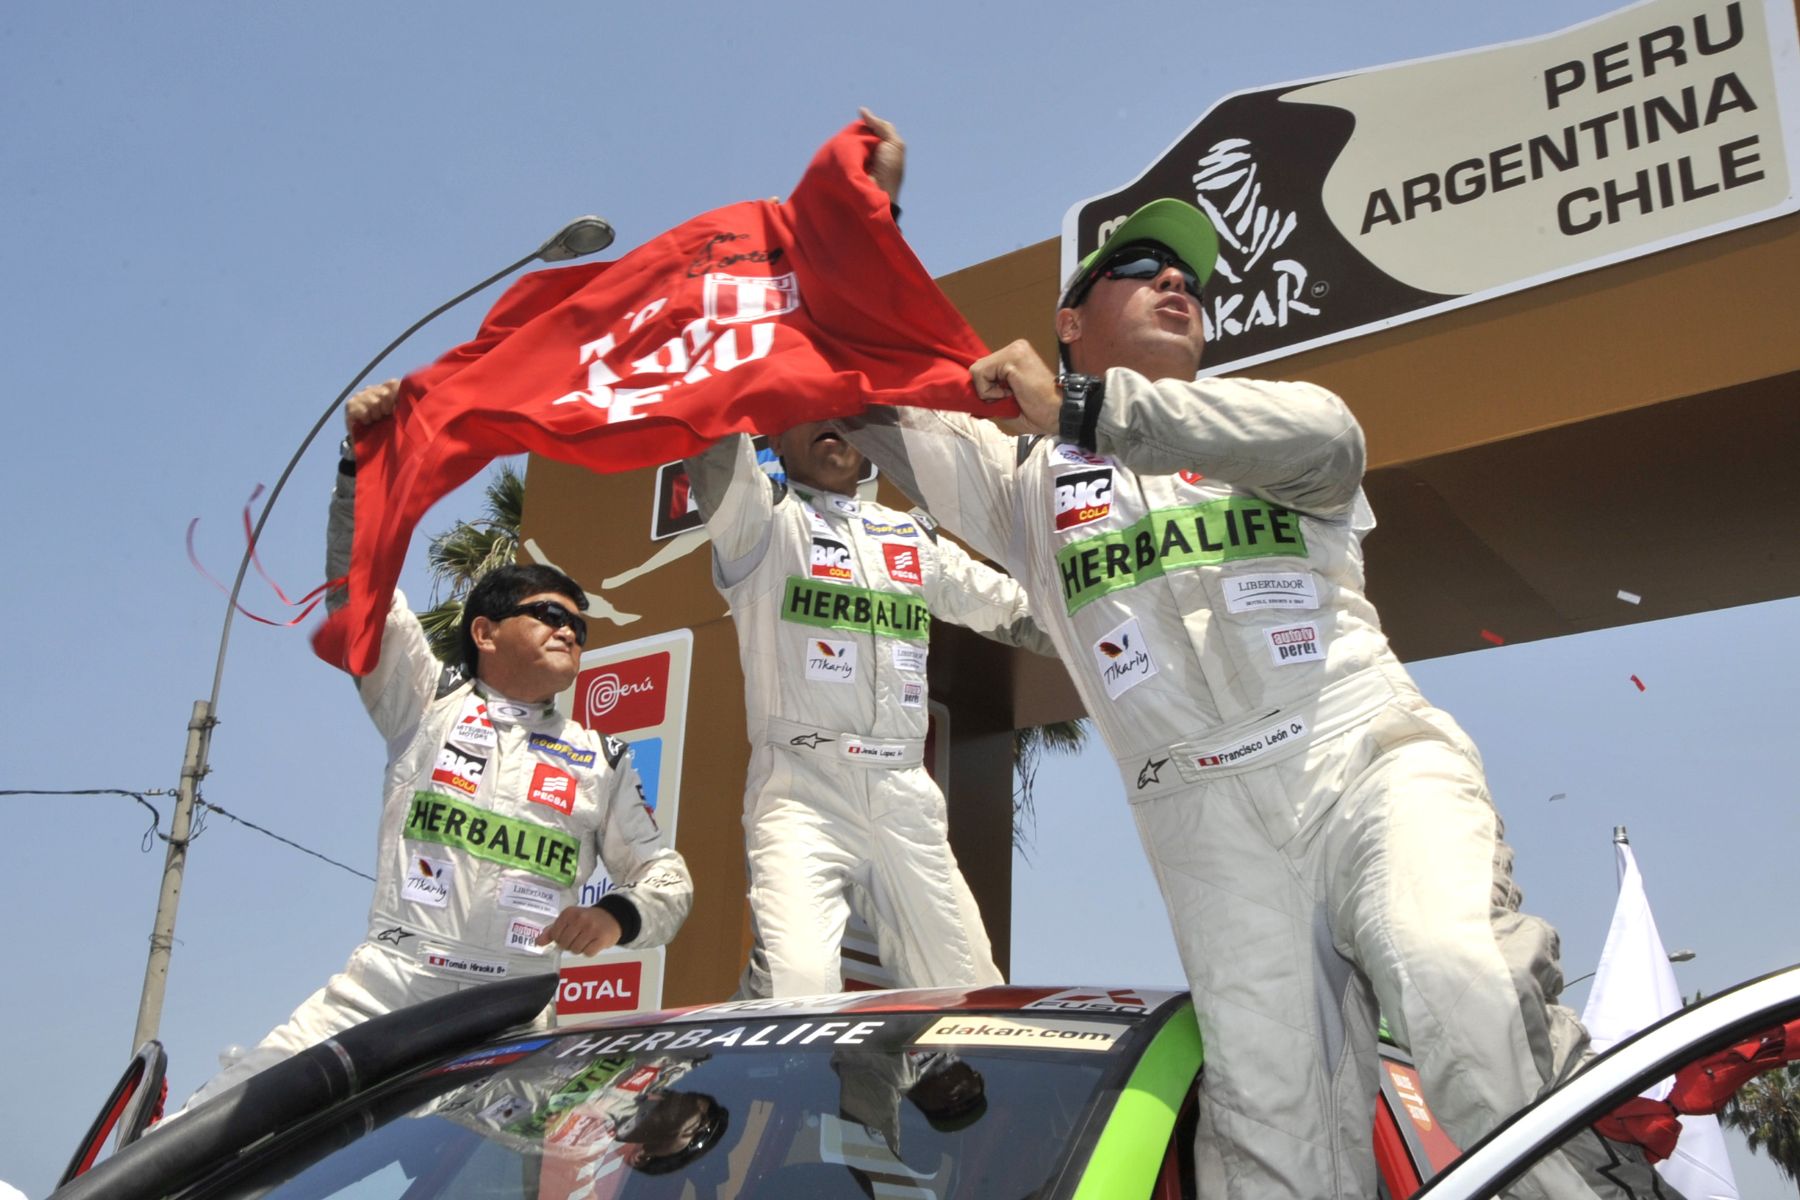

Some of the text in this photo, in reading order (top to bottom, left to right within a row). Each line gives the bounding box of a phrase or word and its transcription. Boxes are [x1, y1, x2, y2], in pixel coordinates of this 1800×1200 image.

[1544, 2, 1744, 110] PERU
[1359, 71, 1758, 235] ARGENTINA
[1556, 135, 1766, 237] CHILE
[1056, 478, 1111, 515] BIG
[1079, 506, 1108, 520] COLA
[812, 544, 851, 567] BIG
[1061, 508, 1297, 599] HERBALIFE
[829, 568, 852, 578] COLA
[1238, 579, 1304, 592] LIBERTADOR
[1218, 741, 1263, 764] Francisco
[1265, 729, 1288, 746] León
[435, 748, 483, 782] BIG
[452, 776, 476, 793] COLA
[410, 800, 575, 875] HERBALIFE
[581, 876, 615, 905] hil
[555, 978, 632, 1003] TOTAL
[1032, 1001, 1147, 1015] FUSO
[556, 1021, 884, 1059] HERBALIFE
[935, 1024, 1111, 1041] dakar.com
